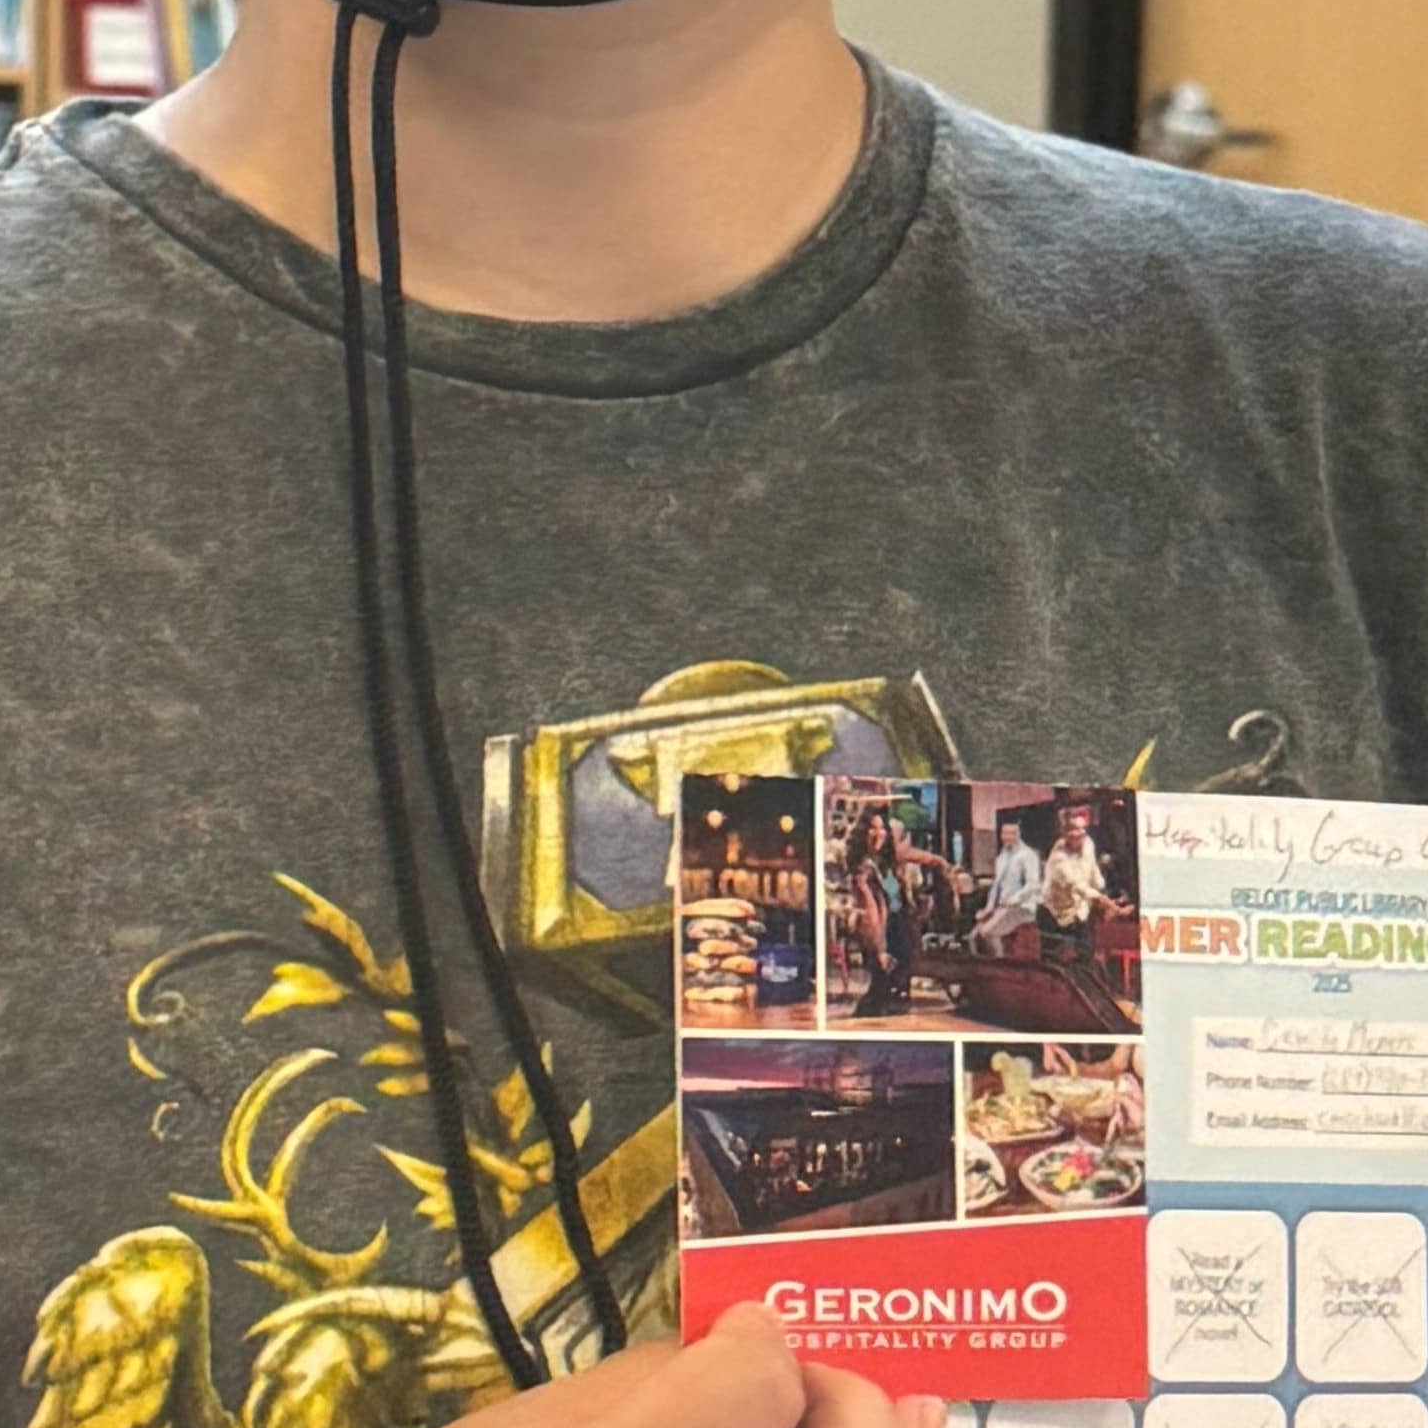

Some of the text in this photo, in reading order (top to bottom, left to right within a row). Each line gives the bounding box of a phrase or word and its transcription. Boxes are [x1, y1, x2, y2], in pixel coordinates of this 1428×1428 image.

[1140, 916, 1243, 957] MER
[765, 1280, 1067, 1322] GERONIMO
[784, 1332, 1067, 1349] OSPITALITY GROUP
